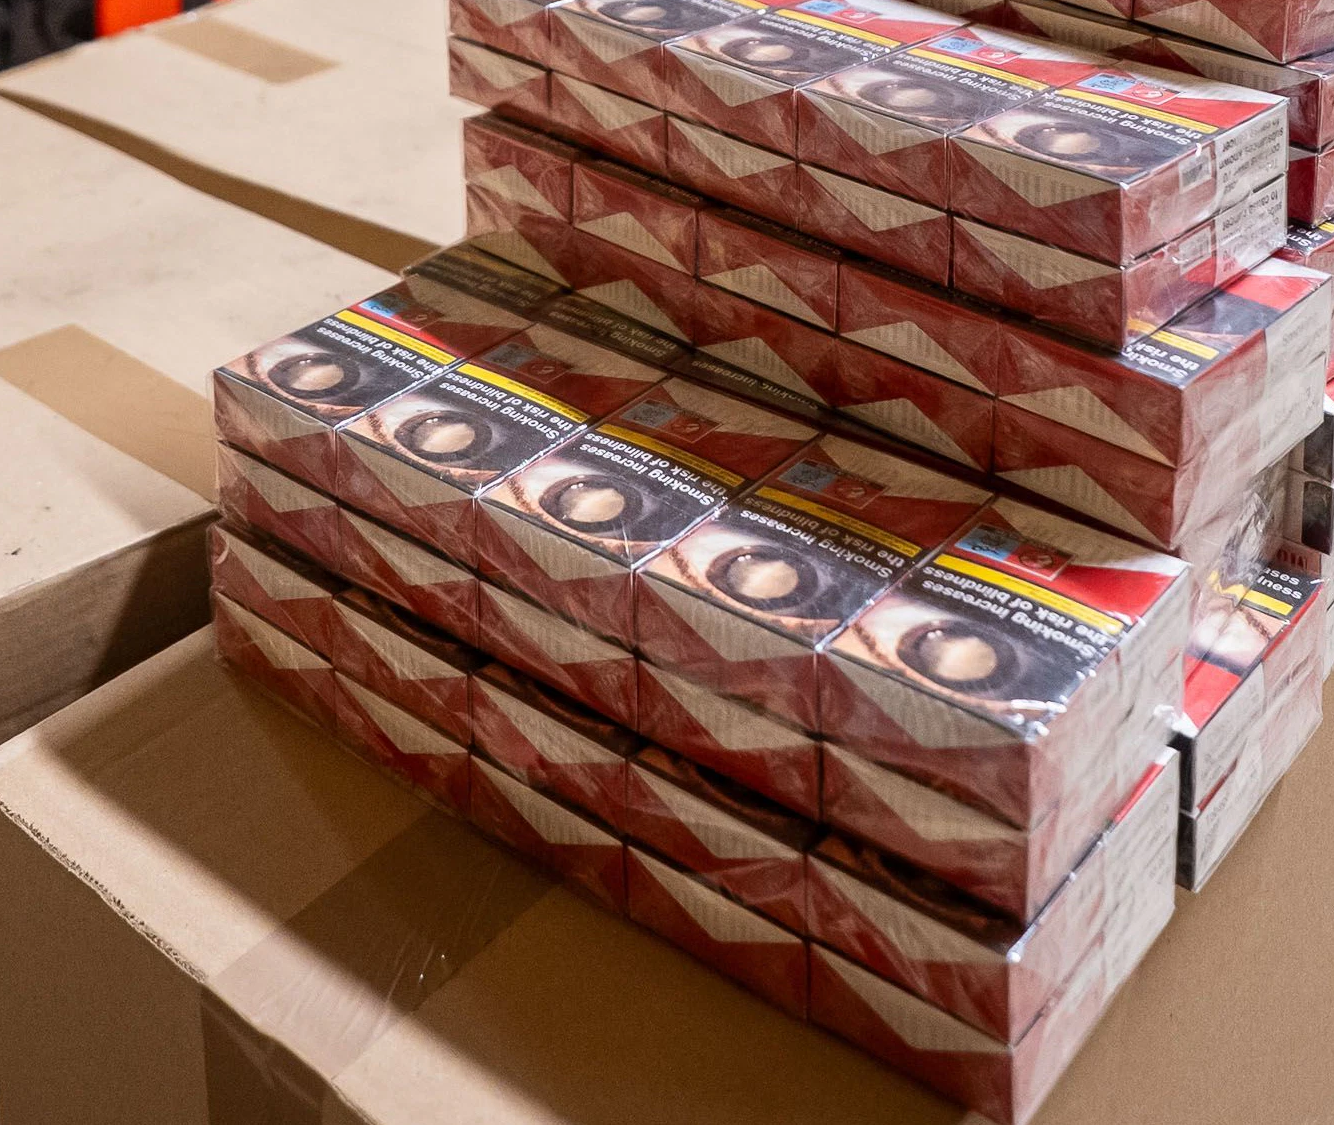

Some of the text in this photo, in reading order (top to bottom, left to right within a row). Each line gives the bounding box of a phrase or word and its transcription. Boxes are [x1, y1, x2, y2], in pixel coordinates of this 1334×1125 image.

[892, 60, 1022, 100] Smoking increases
[1043, 102, 1192, 145] Smoking increases
[316, 326, 372, 353] increases
[322, 315, 379, 345] blindness
[370, 349, 425, 378] Smoking
[1169, 355, 1200, 371] the
[438, 382, 501, 411] increases
[445, 370, 507, 401] blindness
[499, 406, 559, 439] Smoking
[579, 443, 648, 474] increases
[584, 433, 653, 463] blindness
[646, 468, 714, 506] Smoking
[739, 510, 815, 545] increases
[743, 497, 819, 530] blindness
[817, 539, 892, 578] Smoking
[922, 566, 1011, 604] blindness
[922, 580, 1010, 619] increases
[1010, 611, 1098, 658] Smoking
